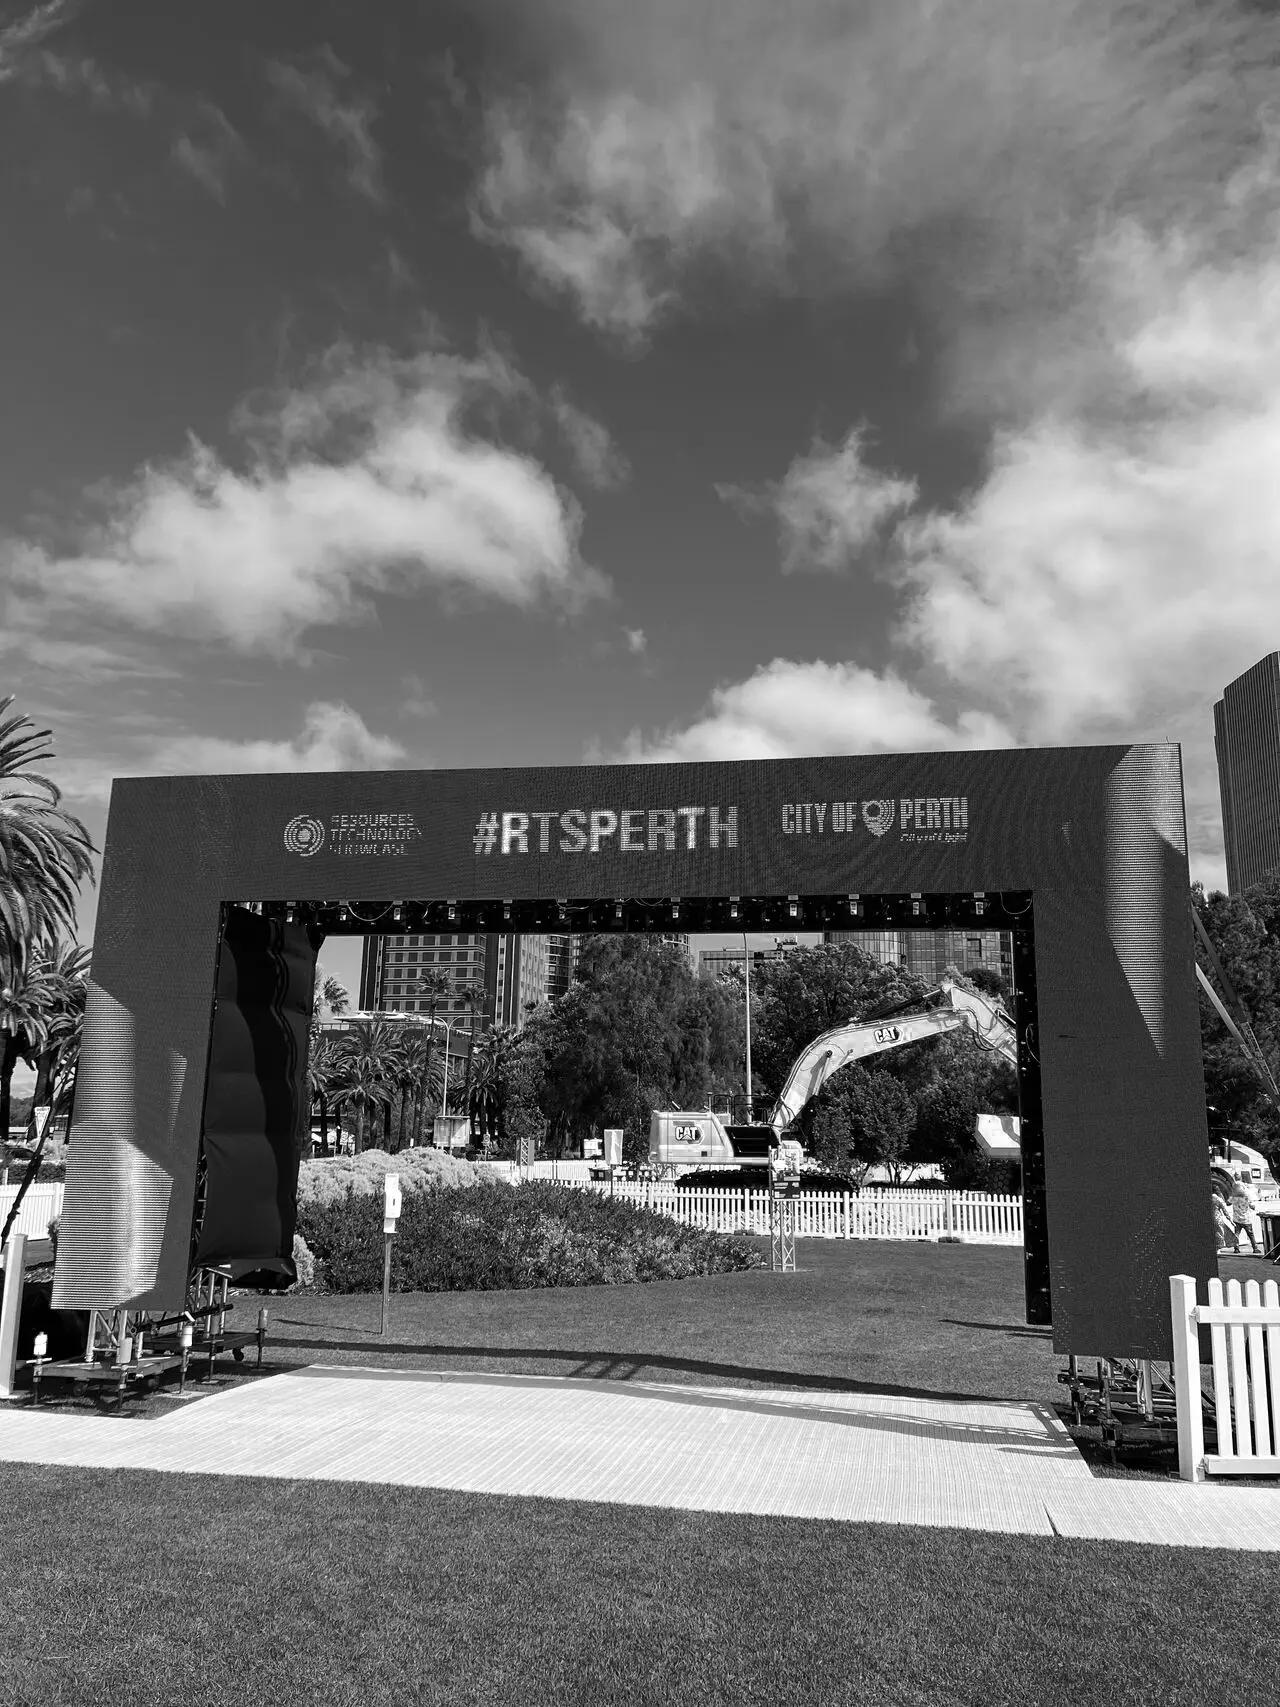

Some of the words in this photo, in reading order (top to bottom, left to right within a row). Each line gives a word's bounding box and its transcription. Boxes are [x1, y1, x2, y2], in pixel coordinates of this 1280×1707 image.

[782, 803, 827, 834] CITY
[832, 802, 857, 832] OF
[900, 797, 968, 829] PERTH
[472, 806, 739, 854] #RTSPERTH
[874, 1026, 896, 1043] CAT
[675, 1126, 698, 1141] CAT
